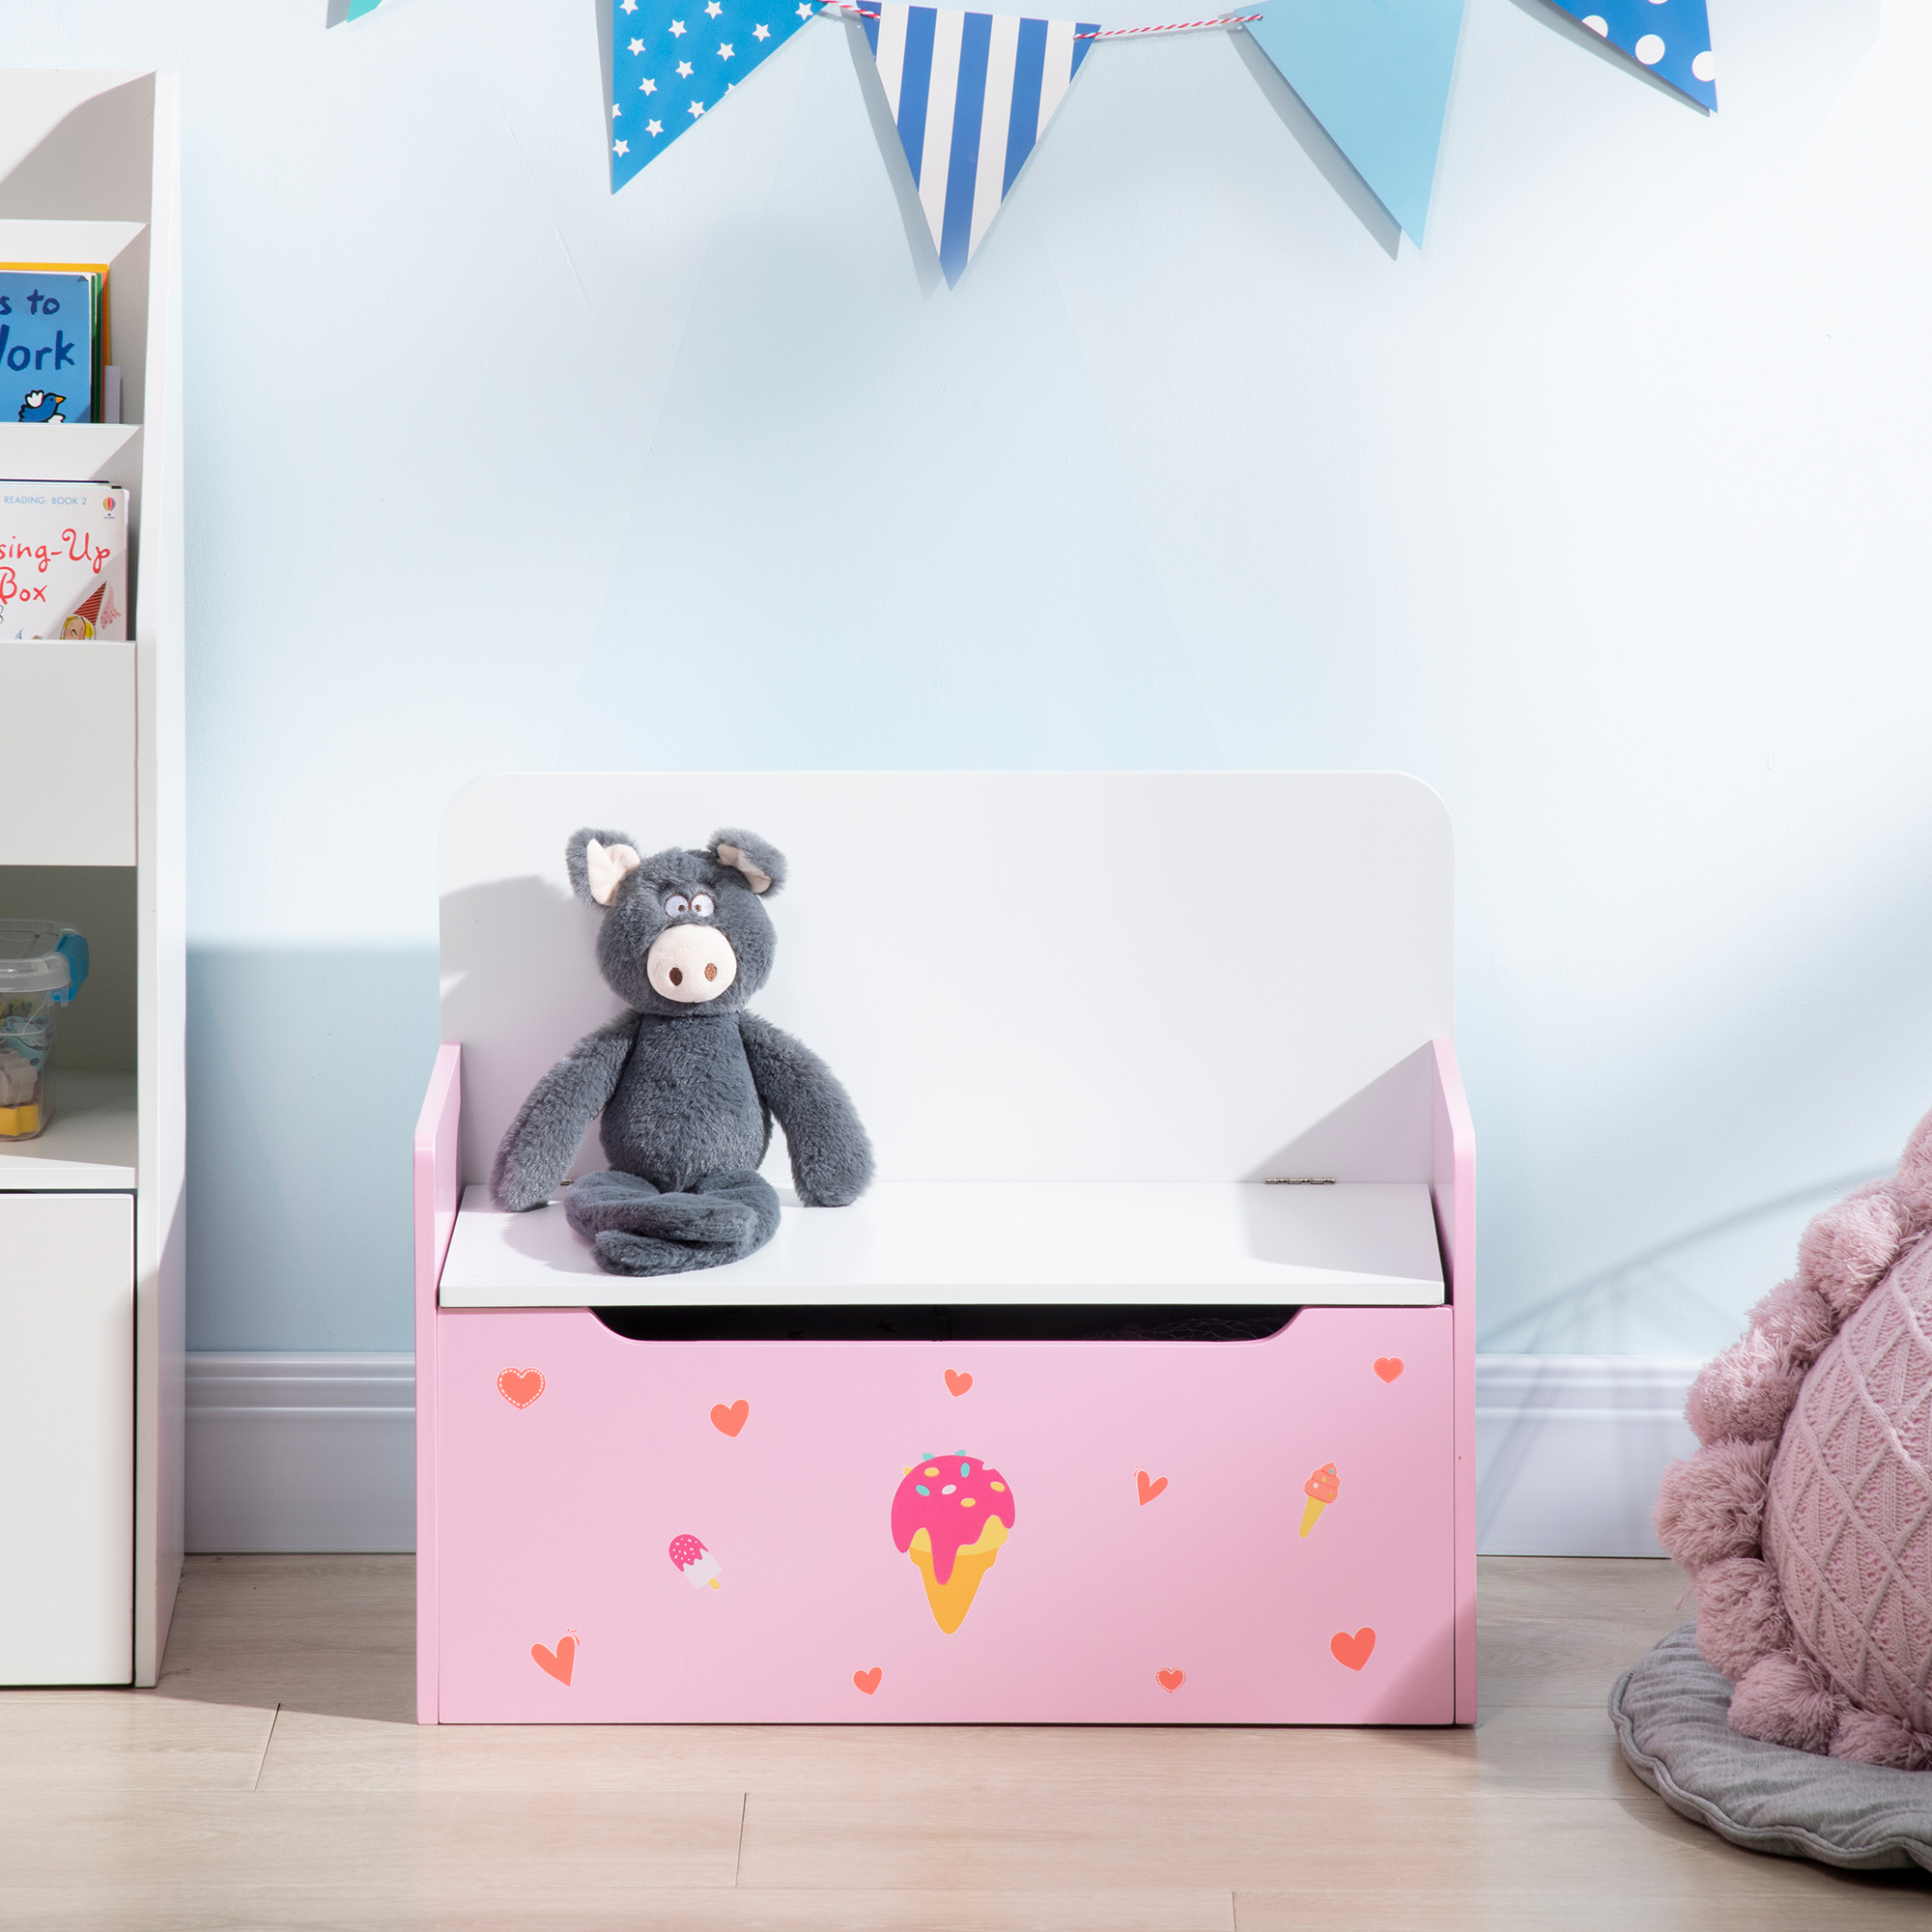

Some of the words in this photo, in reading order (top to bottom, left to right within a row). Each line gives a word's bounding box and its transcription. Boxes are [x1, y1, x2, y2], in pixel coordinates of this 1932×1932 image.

[26, 289, 61, 316] to
[4, 496, 48, 505] READING:
[51, 497, 78, 505] BOOK
[81, 497, 87, 505] 2
[0, 566, 48, 605] Box
